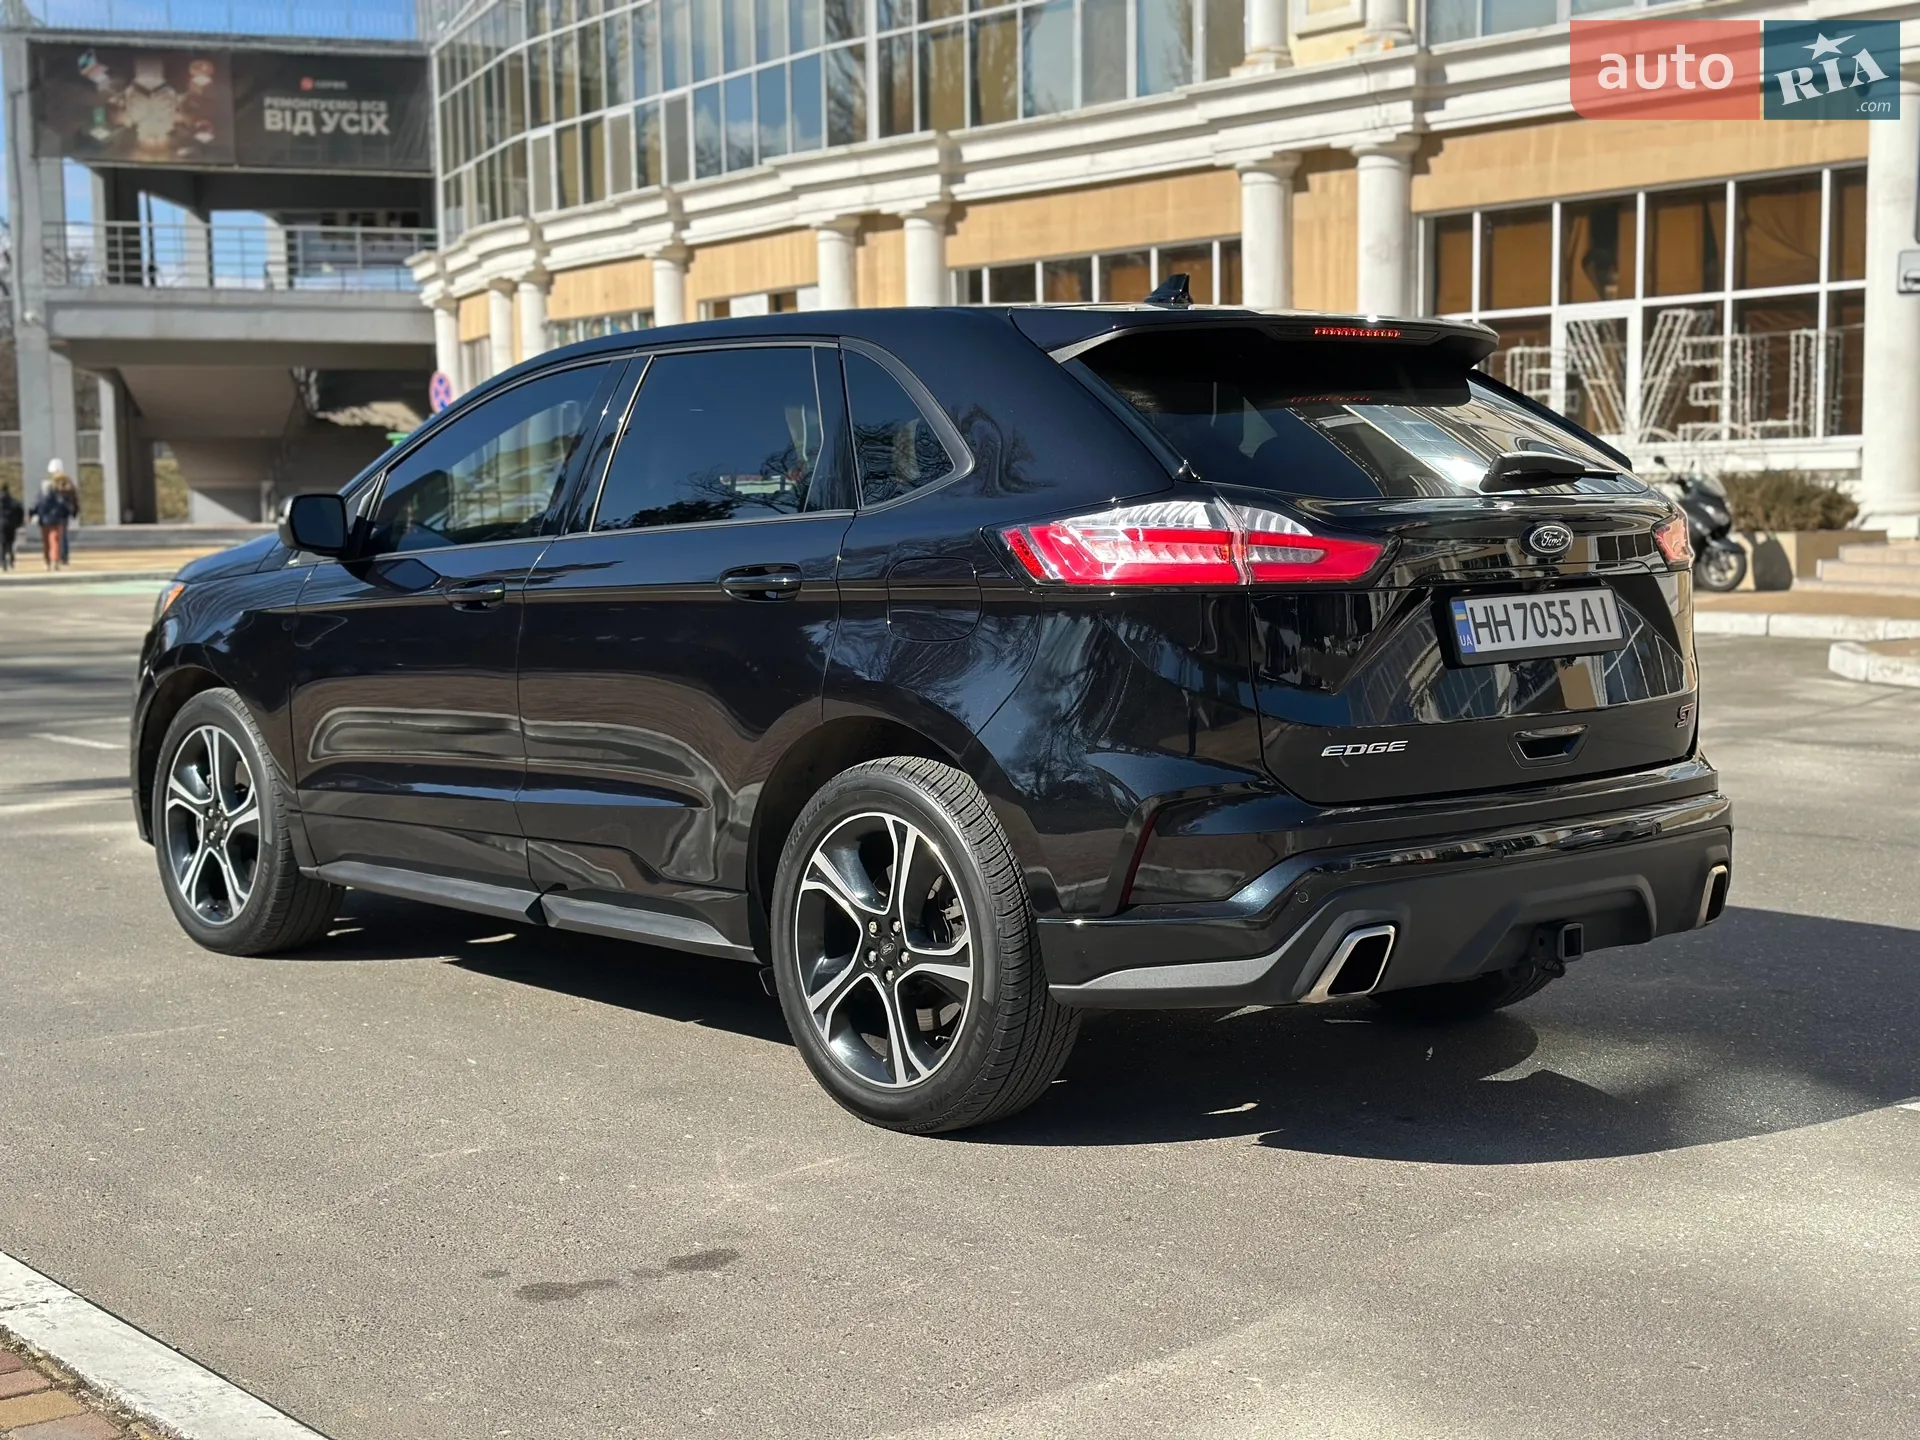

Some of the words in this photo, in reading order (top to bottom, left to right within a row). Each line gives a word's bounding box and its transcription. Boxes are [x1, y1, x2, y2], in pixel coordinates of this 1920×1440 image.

[264, 109, 316, 136] ВІД
[320, 111, 390, 135] УСІХ
[1541, 531, 1563, 547] Ford
[1460, 635, 1473, 647] UA
[1321, 740, 1409, 757] EDGE
